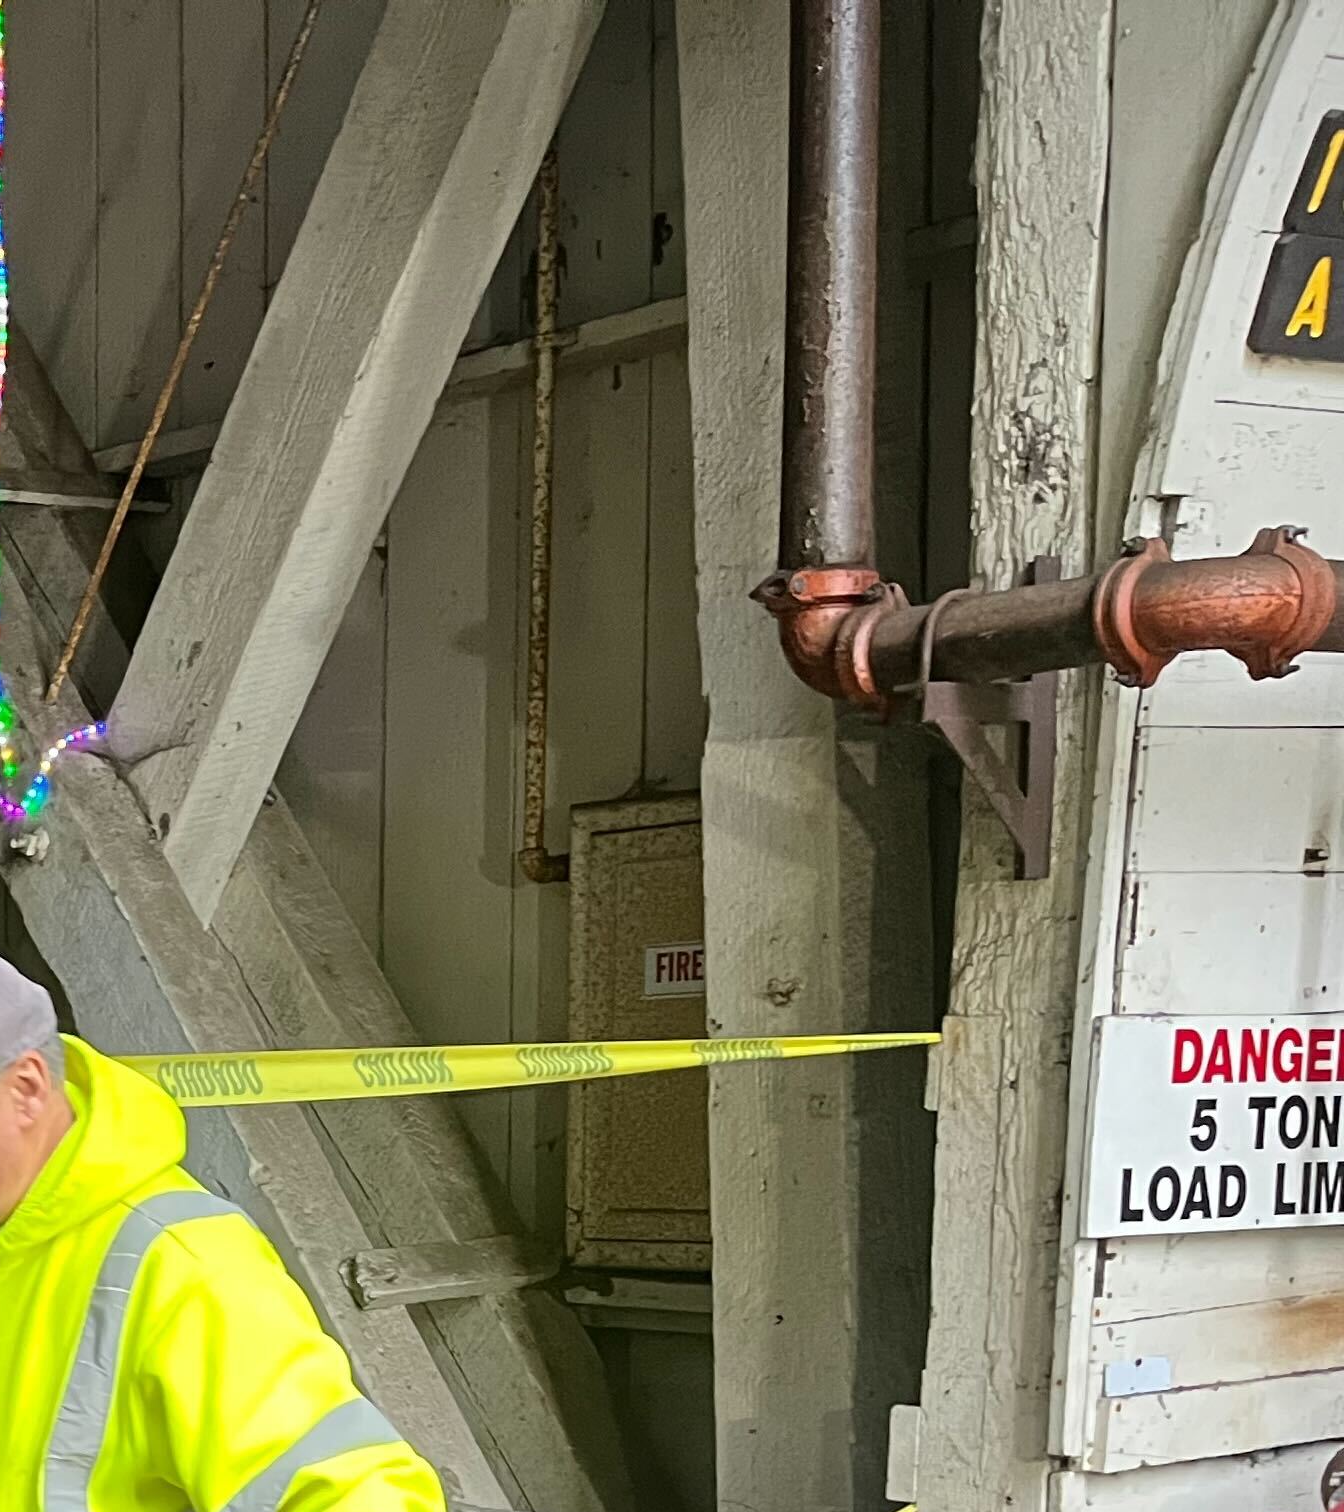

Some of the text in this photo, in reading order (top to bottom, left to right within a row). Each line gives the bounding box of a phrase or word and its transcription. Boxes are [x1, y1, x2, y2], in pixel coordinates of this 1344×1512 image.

[656, 949, 704, 983] FIRE
[1171, 1028, 1344, 1083] DANGE
[1190, 1098, 1218, 1151] 5
[1120, 1164, 1247, 1223] LOAD
